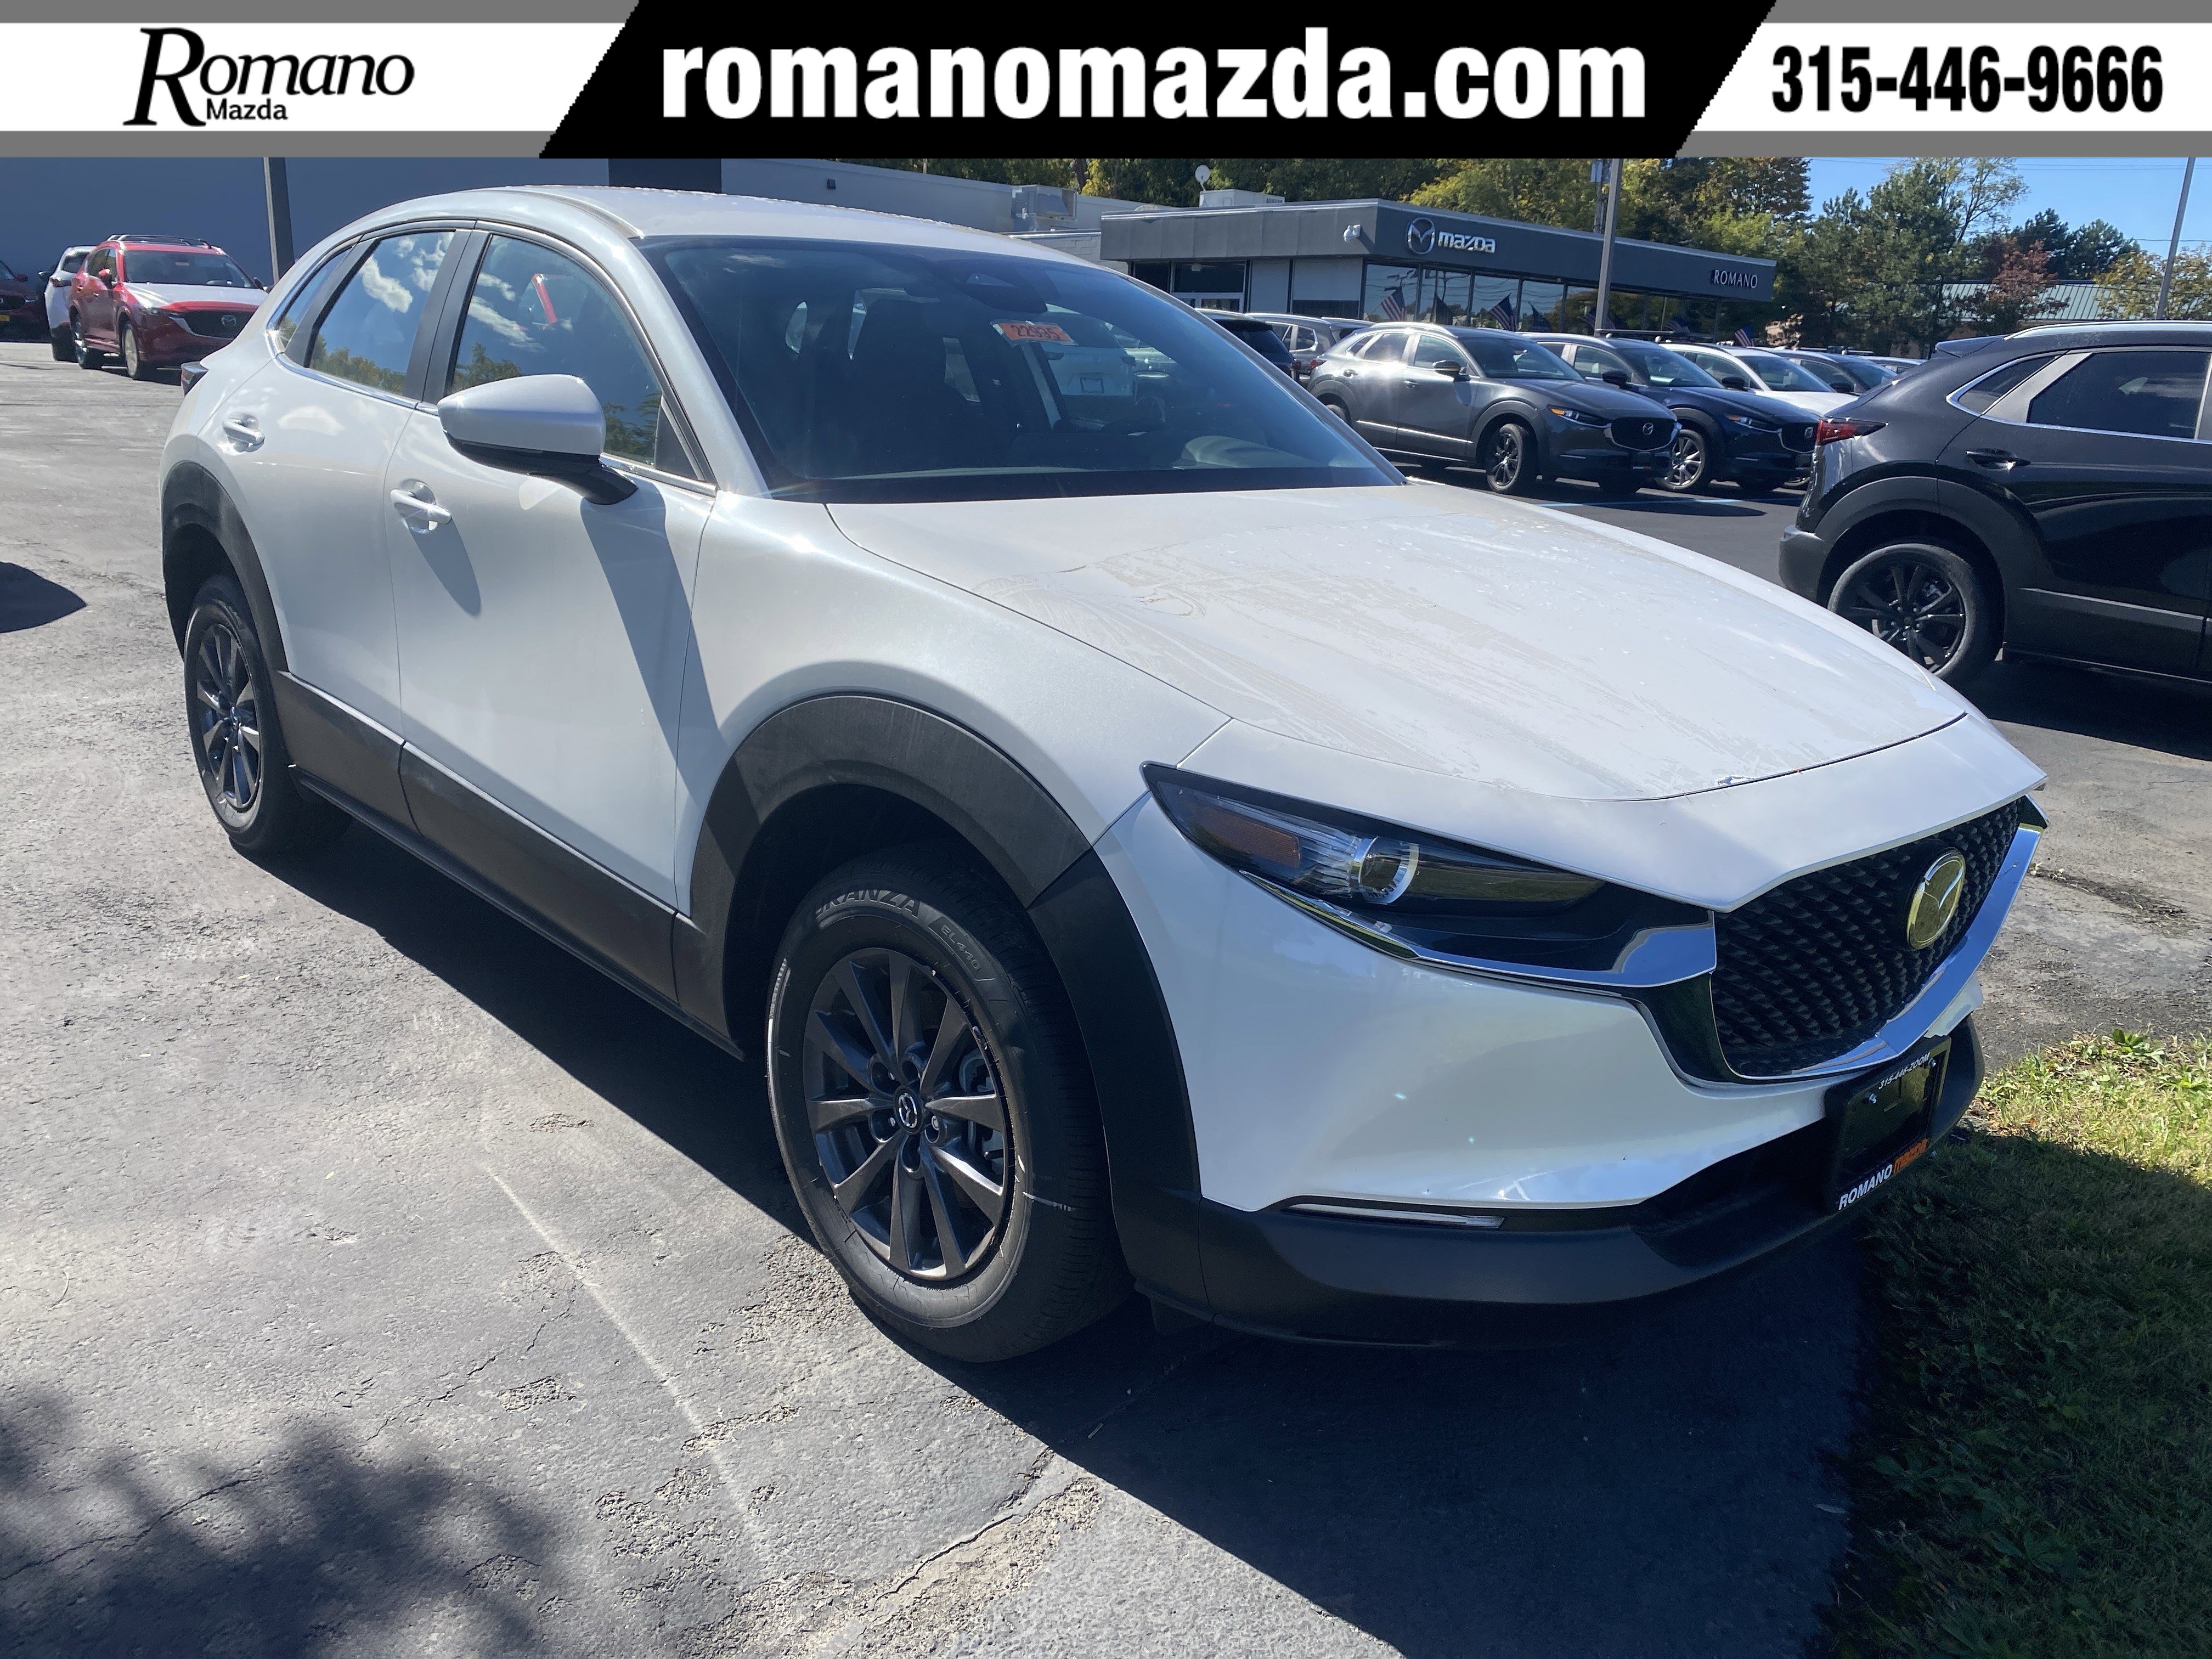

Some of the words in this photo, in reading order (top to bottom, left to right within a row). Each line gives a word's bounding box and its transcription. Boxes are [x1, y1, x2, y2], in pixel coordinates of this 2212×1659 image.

[1714, 269, 1758, 289] ROMANO
[940, 924, 982, 972] EL440
[1838, 1164, 1893, 1211] ROMANO
